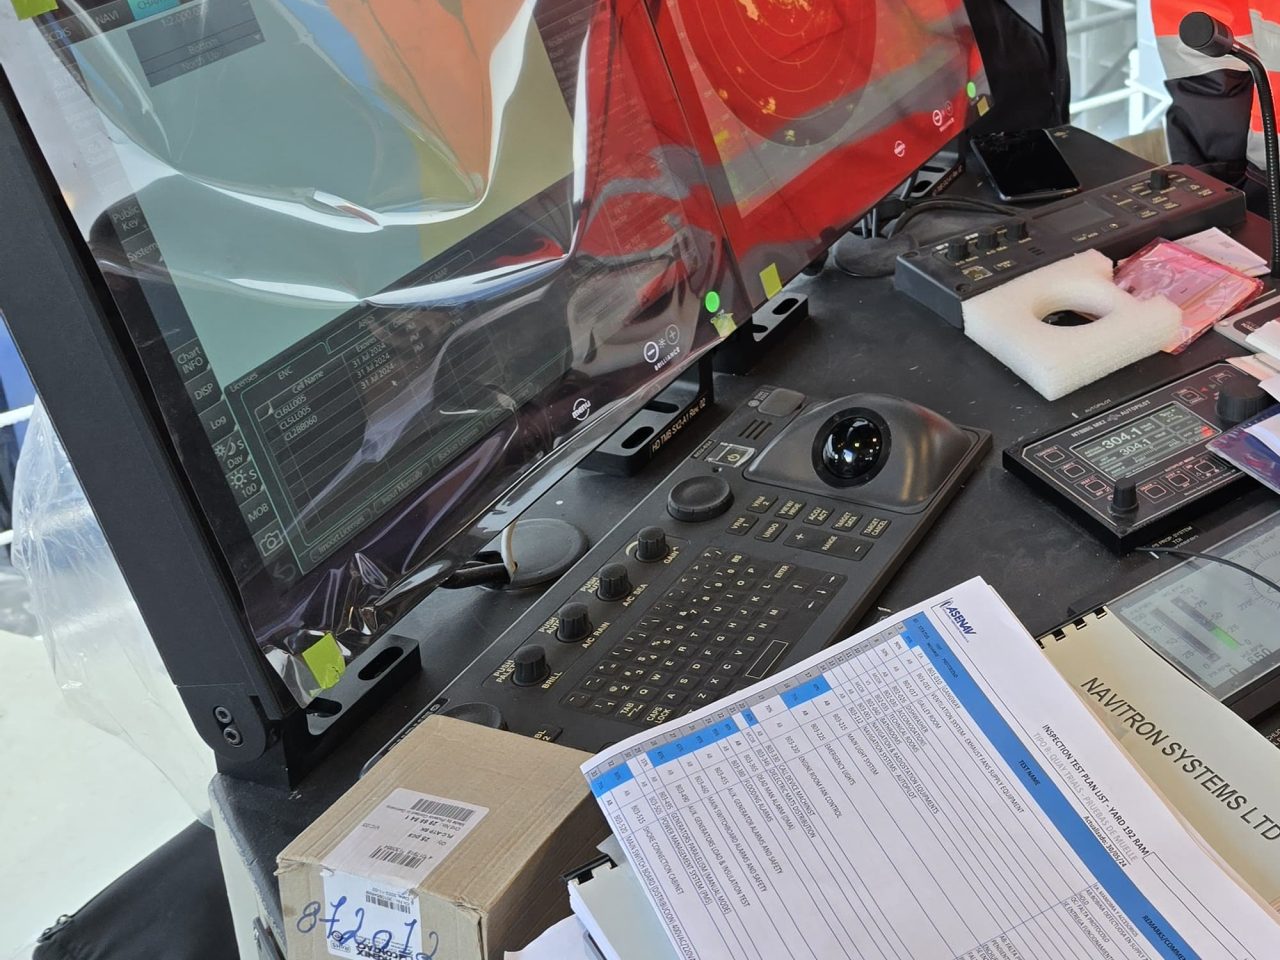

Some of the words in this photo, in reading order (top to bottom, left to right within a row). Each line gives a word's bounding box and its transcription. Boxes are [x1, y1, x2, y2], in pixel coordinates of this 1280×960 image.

[111, 203, 140, 224] Public
[121, 216, 140, 232] Key
[126, 239, 158, 263] System
[175, 345, 201, 365] Chart
[368, 341, 387, 357] 2024
[650, 345, 684, 371] BRILLIANCE
[180, 355, 204, 374] INFO
[373, 352, 392, 367] 2024
[276, 365, 294, 380] ENC
[303, 368, 325, 386] Name
[377, 362, 396, 378] 2024
[193, 382, 216, 400] DISP
[569, 399, 593, 418] menu
[209, 414, 228, 430] Log
[649, 439, 662, 451] HD
[1100, 424, 1142, 451] 304.1
[1119, 436, 1151, 457] 304.1
[225, 453, 245, 469] Day
[240, 482, 258, 497] 100
[245, 501, 270, 521] MOB
[786, 501, 803, 517] HIDE
[815, 508, 829, 522] ACT
[760, 521, 781, 539] UNDO
[832, 511, 853, 529] TARGET
[842, 513, 859, 529] DATA
[861, 516, 882, 535] TARGET
[869, 518, 890, 537] CANCEL
[819, 533, 840, 551] RANGE
[662, 549, 680, 565] GAIN
[772, 563, 791, 580] ENTER
[578, 574, 600, 593] PUSH
[621, 594, 636, 607] A/C
[632, 581, 649, 596] SEA
[537, 615, 559, 634] PUSH
[942, 604, 978, 638] ASENAV
[581, 634, 596, 649] A/C
[592, 619, 612, 638] RAIN
[492, 657, 515, 678] PUSH
[539, 669, 565, 691] BRILL
[618, 700, 636, 716] TAB
[644, 704, 665, 723] CAPS
[652, 706, 674, 726] LOCK
[845, 733, 859, 746] MAIN
[854, 744, 867, 759] LIGHT
[862, 757, 879, 776] SYSTEM
[928, 692, 954, 720] VENTILATION
[948, 718, 967, 737] SYSTEM
[963, 737, 983, 758] EXHAUST
[978, 757, 992, 770] FANS
[986, 769, 1004, 786] SUPPLY
[998, 785, 1025, 814] EQUIPMENT
[1081, 677, 1168, 748] NAVITRON
[1161, 740, 1247, 814] SYSTEMS
[823, 743, 846, 770] EMERGENCY
[841, 768, 856, 786] LIGHTS
[861, 726, 884, 753] NAVIGATION
[879, 751, 898, 772] SYSTEMS
[894, 773, 917, 800] AUTOPILOT
[870, 721, 893, 749] NAVIGATION
[891, 751, 919, 785] RADIOSTATION
[913, 783, 940, 815] EQUIPMENTS
[1017, 759, 1030, 772] TEST
[1025, 770, 1041, 786] NAME
[797, 755, 813, 773] ENGINE
[808, 771, 822, 787] ROOM
[817, 785, 828, 797] FAN
[823, 795, 843, 818] CONTROL
[1039, 724, 1075, 760] INSPECTION
[1068, 758, 1085, 774] TEST
[1079, 773, 1099, 791] PLAN
[1093, 789, 1109, 804] LIST
[1106, 806, 1127, 826] YARD
[1121, 825, 1136, 839] 192
[1131, 838, 1150, 856] RAM
[743, 779, 762, 804] FLOODING
[757, 802, 773, 822] ALARMS
[1031, 732, 1049, 748] TIPO
[1047, 753, 1068, 774] QUAY
[1062, 772, 1085, 793] TRIALS
[1081, 796, 1111, 826] PRUEBAS
[1105, 824, 1118, 836] DE
[1112, 834, 1139, 862] MUELLE
[706, 795, 719, 810] MAIN
[713, 808, 739, 844] SWITCHBOARD
[733, 842, 750, 864] ALARMS
[745, 861, 757, 875] AND
[751, 872, 767, 893] SAFETY
[1081, 814, 1111, 845] Actualizado:
[1104, 844, 1128, 868] 30/05/24
[660, 817, 674, 835] POWER
[669, 833, 694, 871] MANAGEMENT
[688, 869, 704, 890] SYSTEM
[699, 889, 712, 905] (PMS)
[670, 811, 692, 843] GENERATORS
[687, 841, 708, 873] PARALELISM
[702, 870, 722, 897] (MANUAL
[715, 894, 732, 915] MODE)
[624, 835, 637, 851] MAIN
[631, 848, 646, 869] SWITCH
[641, 867, 655, 886] BOARD
[649, 884, 676, 925] (DISTRIBUCION)
